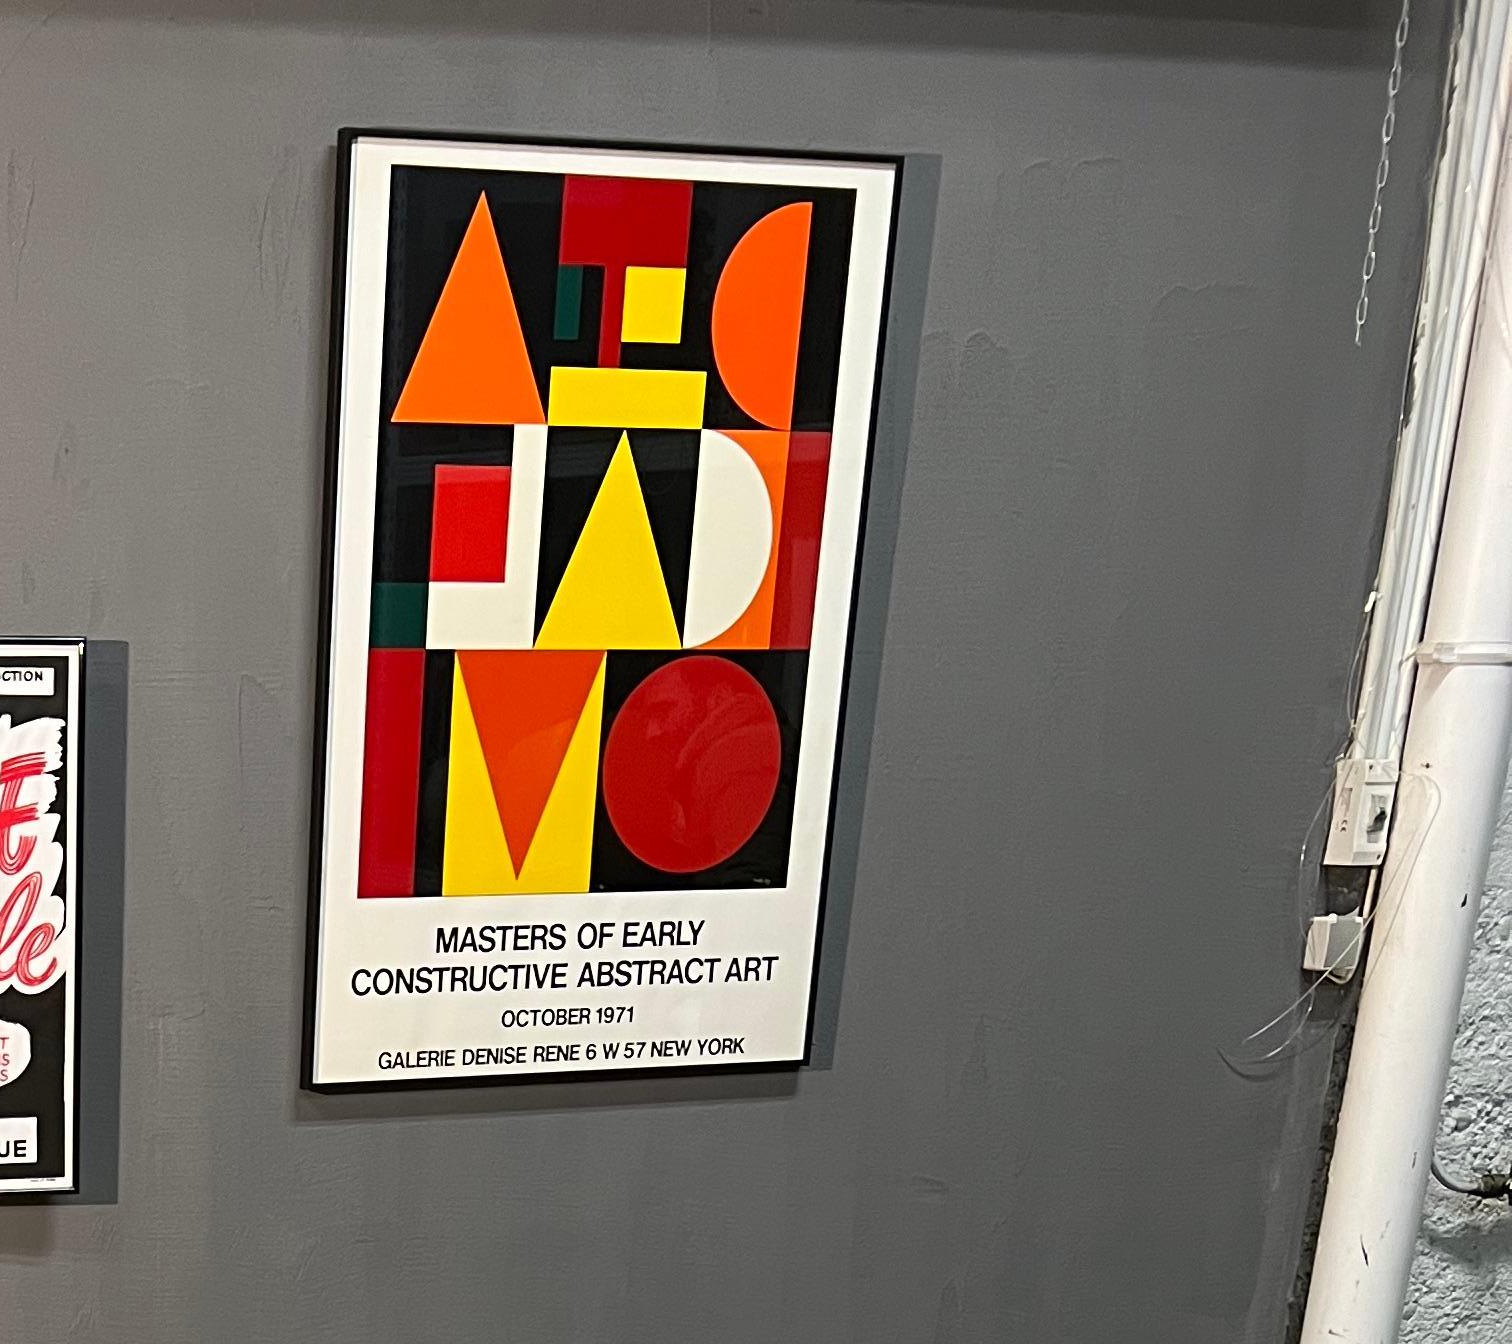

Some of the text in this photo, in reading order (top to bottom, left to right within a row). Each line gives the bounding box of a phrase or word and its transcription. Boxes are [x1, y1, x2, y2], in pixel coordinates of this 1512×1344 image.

[435, 920, 705, 953] MASTERS OF EARLY
[351, 956, 779, 996] CONSTRUCTIVE ABSTRACT ART
[501, 1006, 634, 1027] OCTOBER 1971
[378, 1037, 745, 1070] GALERIE DENISE RENE 6 W 57 NEW YORK
